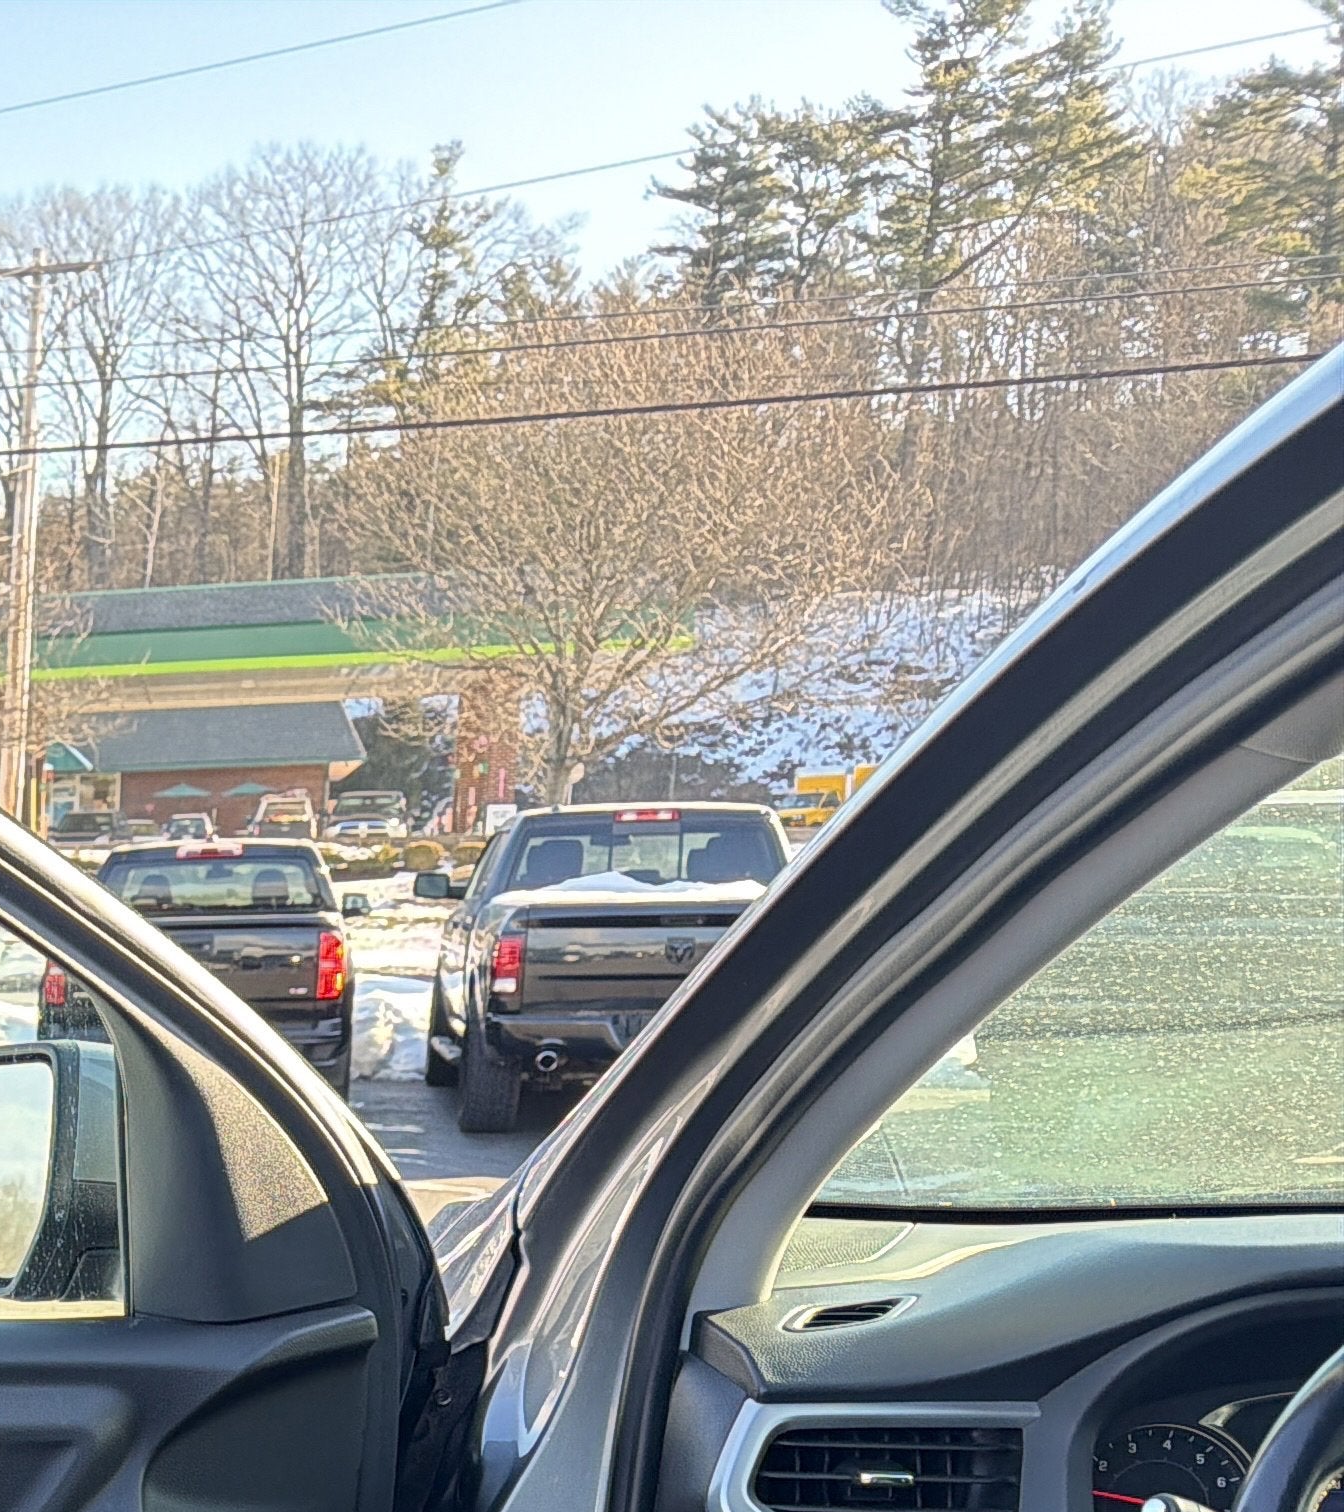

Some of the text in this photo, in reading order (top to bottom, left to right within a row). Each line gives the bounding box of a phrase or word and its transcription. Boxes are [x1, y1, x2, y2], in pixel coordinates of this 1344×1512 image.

[1127, 1442, 1137, 1454] 3
[1162, 1439, 1172, 1451] 4
[1195, 1453, 1205, 1465] 5
[1098, 1460, 1108, 1472] 2
[1216, 1477, 1227, 1488] 6
